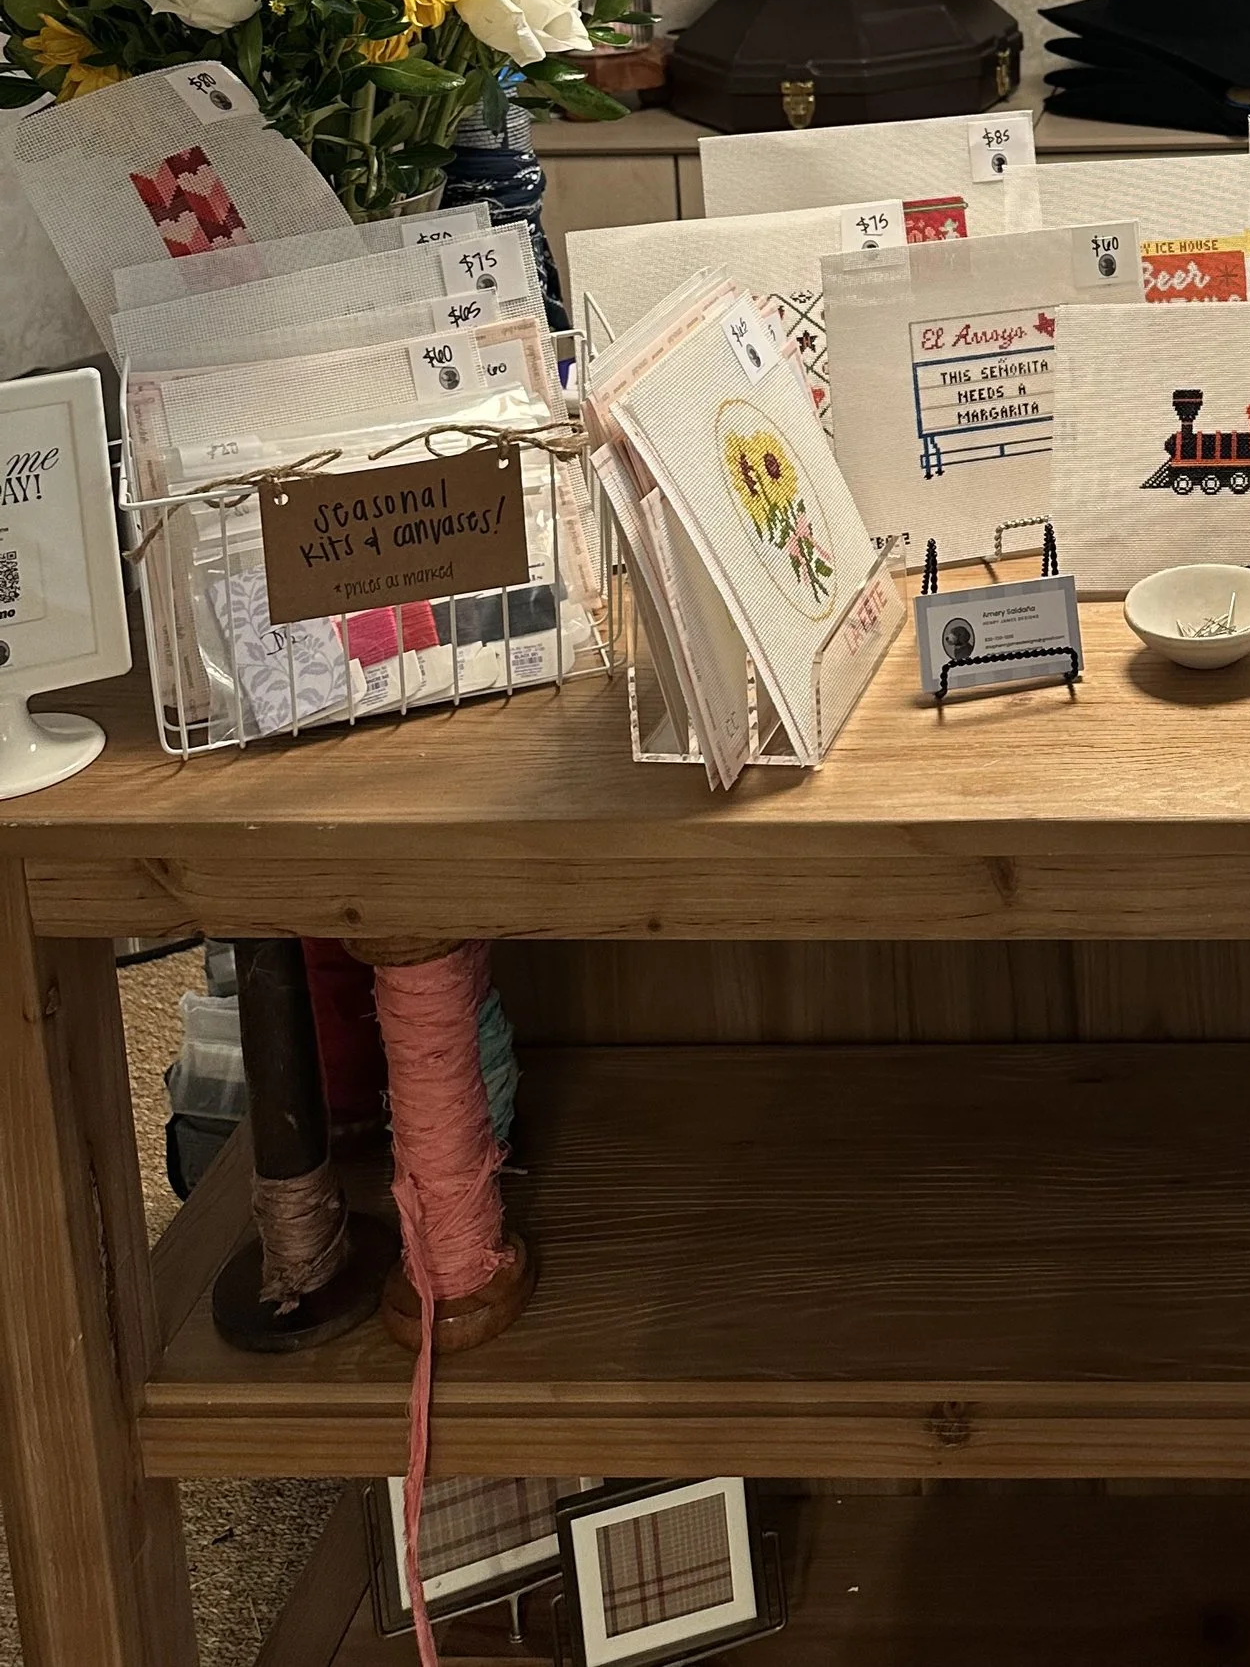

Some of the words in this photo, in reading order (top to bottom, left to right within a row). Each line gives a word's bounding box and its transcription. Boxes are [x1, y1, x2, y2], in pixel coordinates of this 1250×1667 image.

[982, 128, 1010, 148] $85
[856, 213, 889, 234] $75
[1091, 235, 1119, 257] $60
[1155, 242, 1175, 253] ICE
[1180, 240, 1219, 252] HOUSE
[459, 250, 497, 278] $75
[1142, 260, 1211, 295] Beer
[448, 301, 481, 327] $65
[921, 327, 945, 350] El
[952, 324, 1027, 349] Arroyo
[423, 345, 452, 368] $60
[487, 362, 507, 376] 60
[940, 369, 971, 385] THIS
[981, 357, 1049, 380] SEÑORITA
[958, 385, 1004, 403] NEEDS
[1018, 383, 1026, 395] A
[957, 401, 1040, 424] MARGARITA
[0, 473, 42, 505] AY!
[314, 478, 447, 533] seasonal
[363, 527, 381, 555] &
[393, 495, 506, 548] canvases!
[387, 574, 399, 587] as
[402, 562, 454, 585] marked
